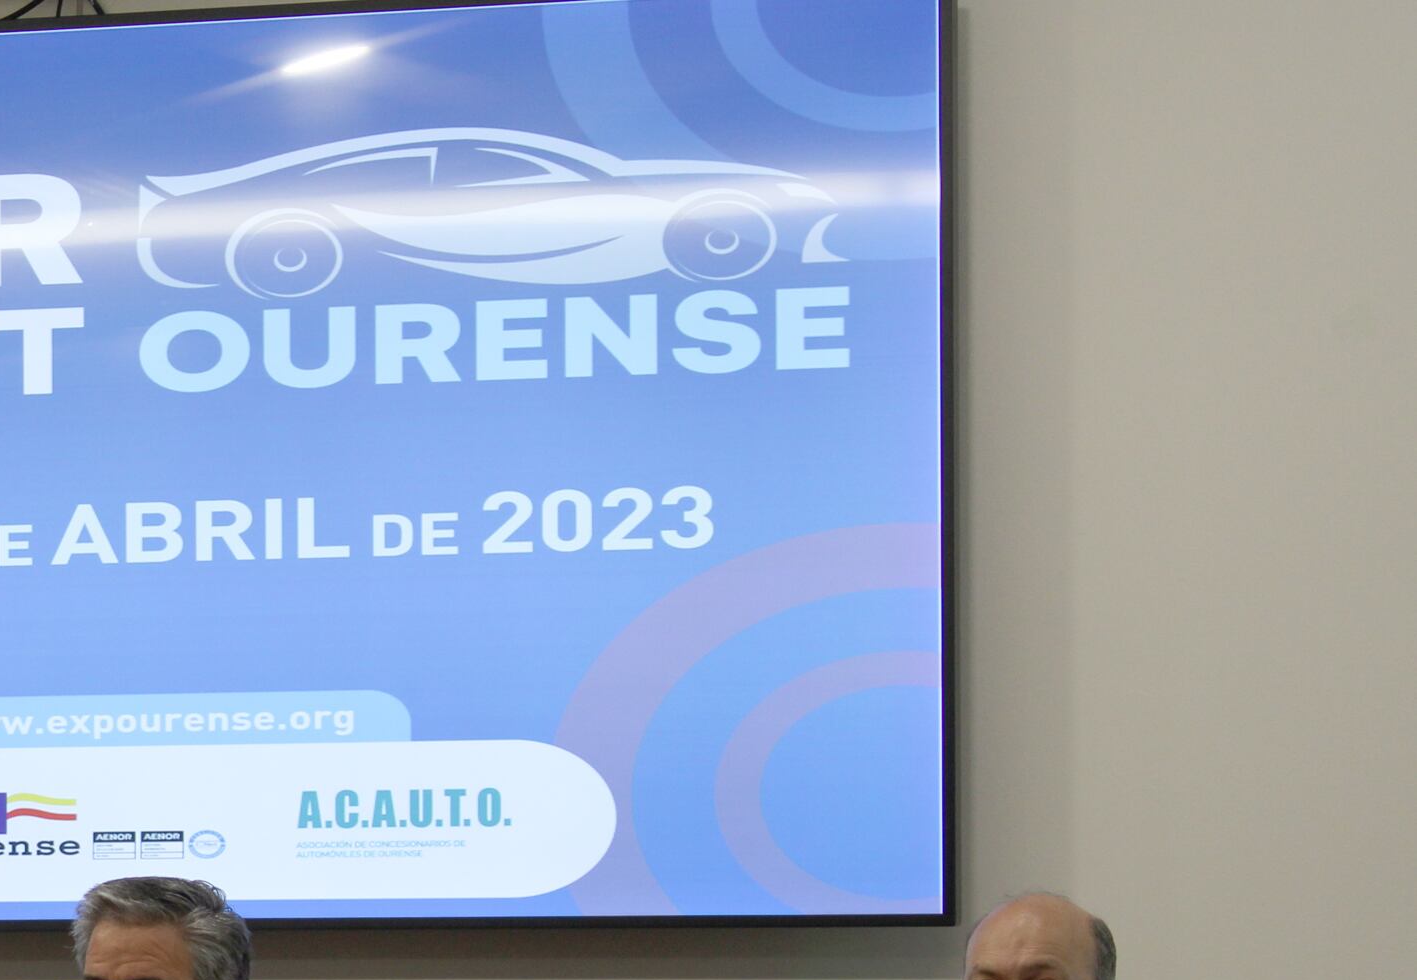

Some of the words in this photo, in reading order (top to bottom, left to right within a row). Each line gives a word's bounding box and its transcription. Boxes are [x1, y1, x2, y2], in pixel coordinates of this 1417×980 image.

[139, 286, 850, 393] OURENSE
[50, 497, 350, 566] ABRIL
[372, 512, 460, 557] DE
[482, 486, 714, 554] 2023
[297, 787, 512, 829] A.C.A.U.T.O.
[95, 833, 133, 841] AENOR
[143, 832, 181, 840] AENOR
